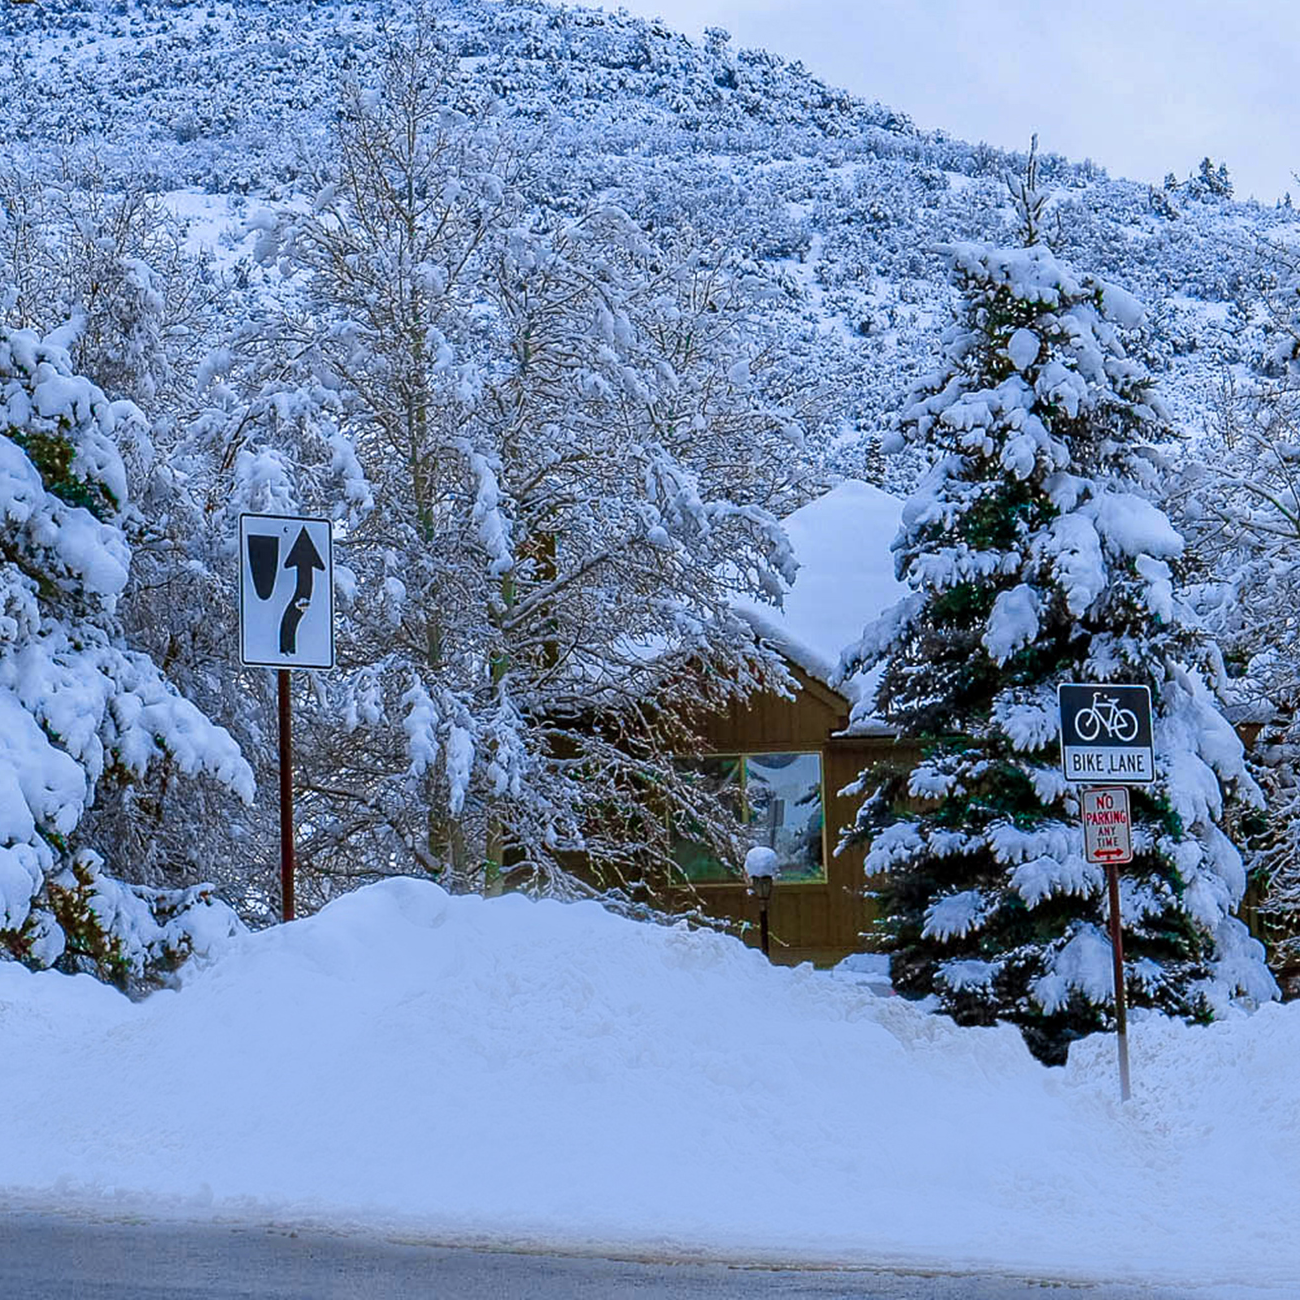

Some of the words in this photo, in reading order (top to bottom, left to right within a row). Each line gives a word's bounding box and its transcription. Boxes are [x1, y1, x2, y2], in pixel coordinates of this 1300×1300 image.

[1073, 754, 1104, 771] BIKE
[1110, 754, 1145, 772] LANE
[1096, 795, 1113, 809] NO
[1086, 810, 1126, 826] PARKING
[1098, 827, 1116, 836] ANY
[1097, 837, 1118, 847] TIME
